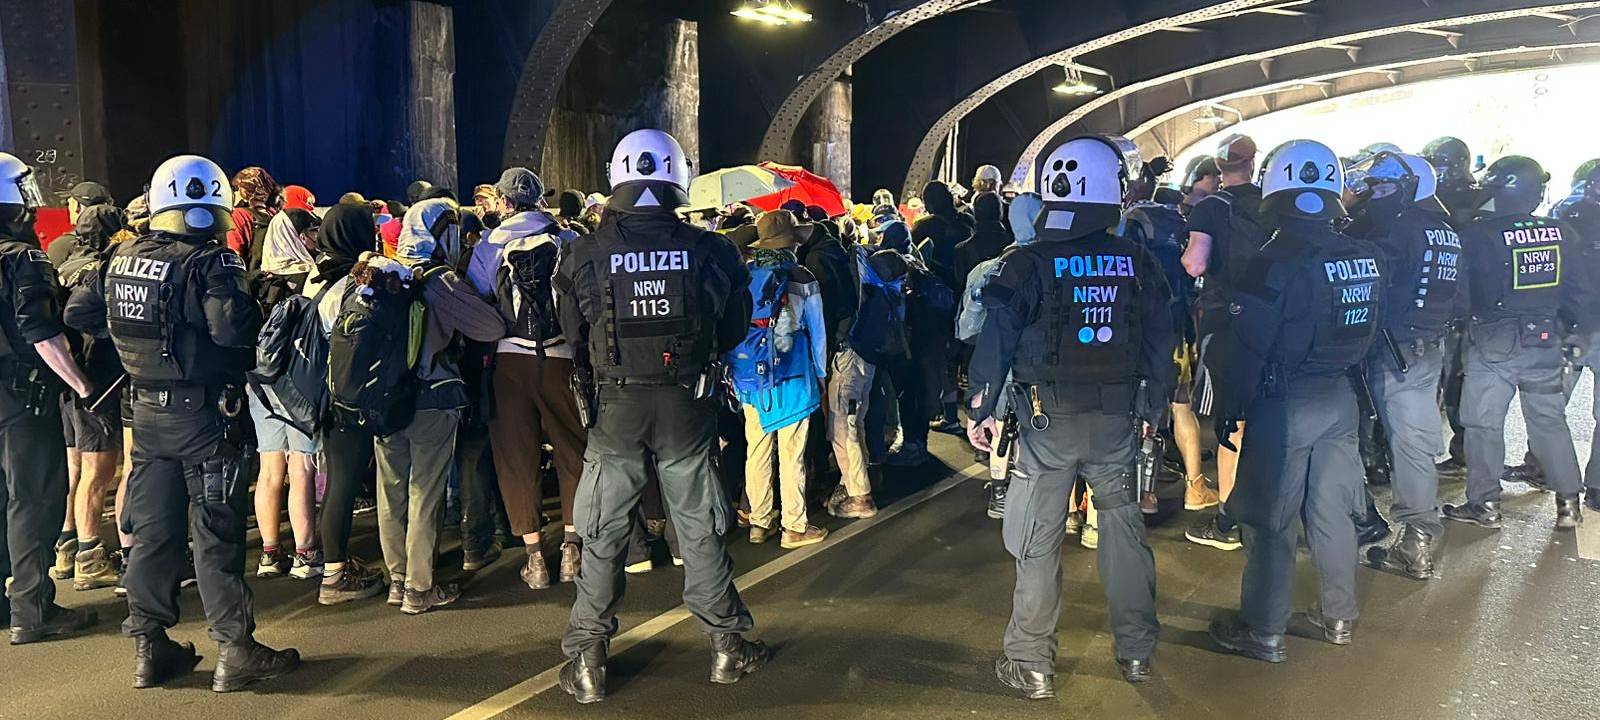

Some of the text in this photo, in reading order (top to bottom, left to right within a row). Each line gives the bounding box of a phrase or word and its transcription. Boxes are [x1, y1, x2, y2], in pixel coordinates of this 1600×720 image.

[622, 154, 671, 174] 1 1
[1283, 162, 1336, 182] 1 2
[168, 179, 222, 197] 1 2
[1043, 174, 1086, 196] 1 1
[1505, 174, 1517, 187] 2
[1503, 227, 1562, 245] POLIZEI
[610, 250, 689, 274] POLIZEI
[1437, 251, 1458, 267] NRW
[1523, 250, 1550, 264] NRW
[107, 255, 171, 282] POLIZEI
[1054, 255, 1135, 278] POLIZEI
[1324, 258, 1380, 282] POLIZEI
[1437, 266, 1457, 281] 1122
[1520, 262, 1555, 274] 3 BF 23
[115, 282, 148, 303] NRW
[633, 279, 666, 297] NRW
[1073, 285, 1118, 303] NRW
[1341, 285, 1372, 304] NRW
[117, 301, 145, 320] 1122
[630, 298, 670, 317] 1113
[1081, 306, 1112, 324] 1111
[1344, 307, 1369, 325] 1122
